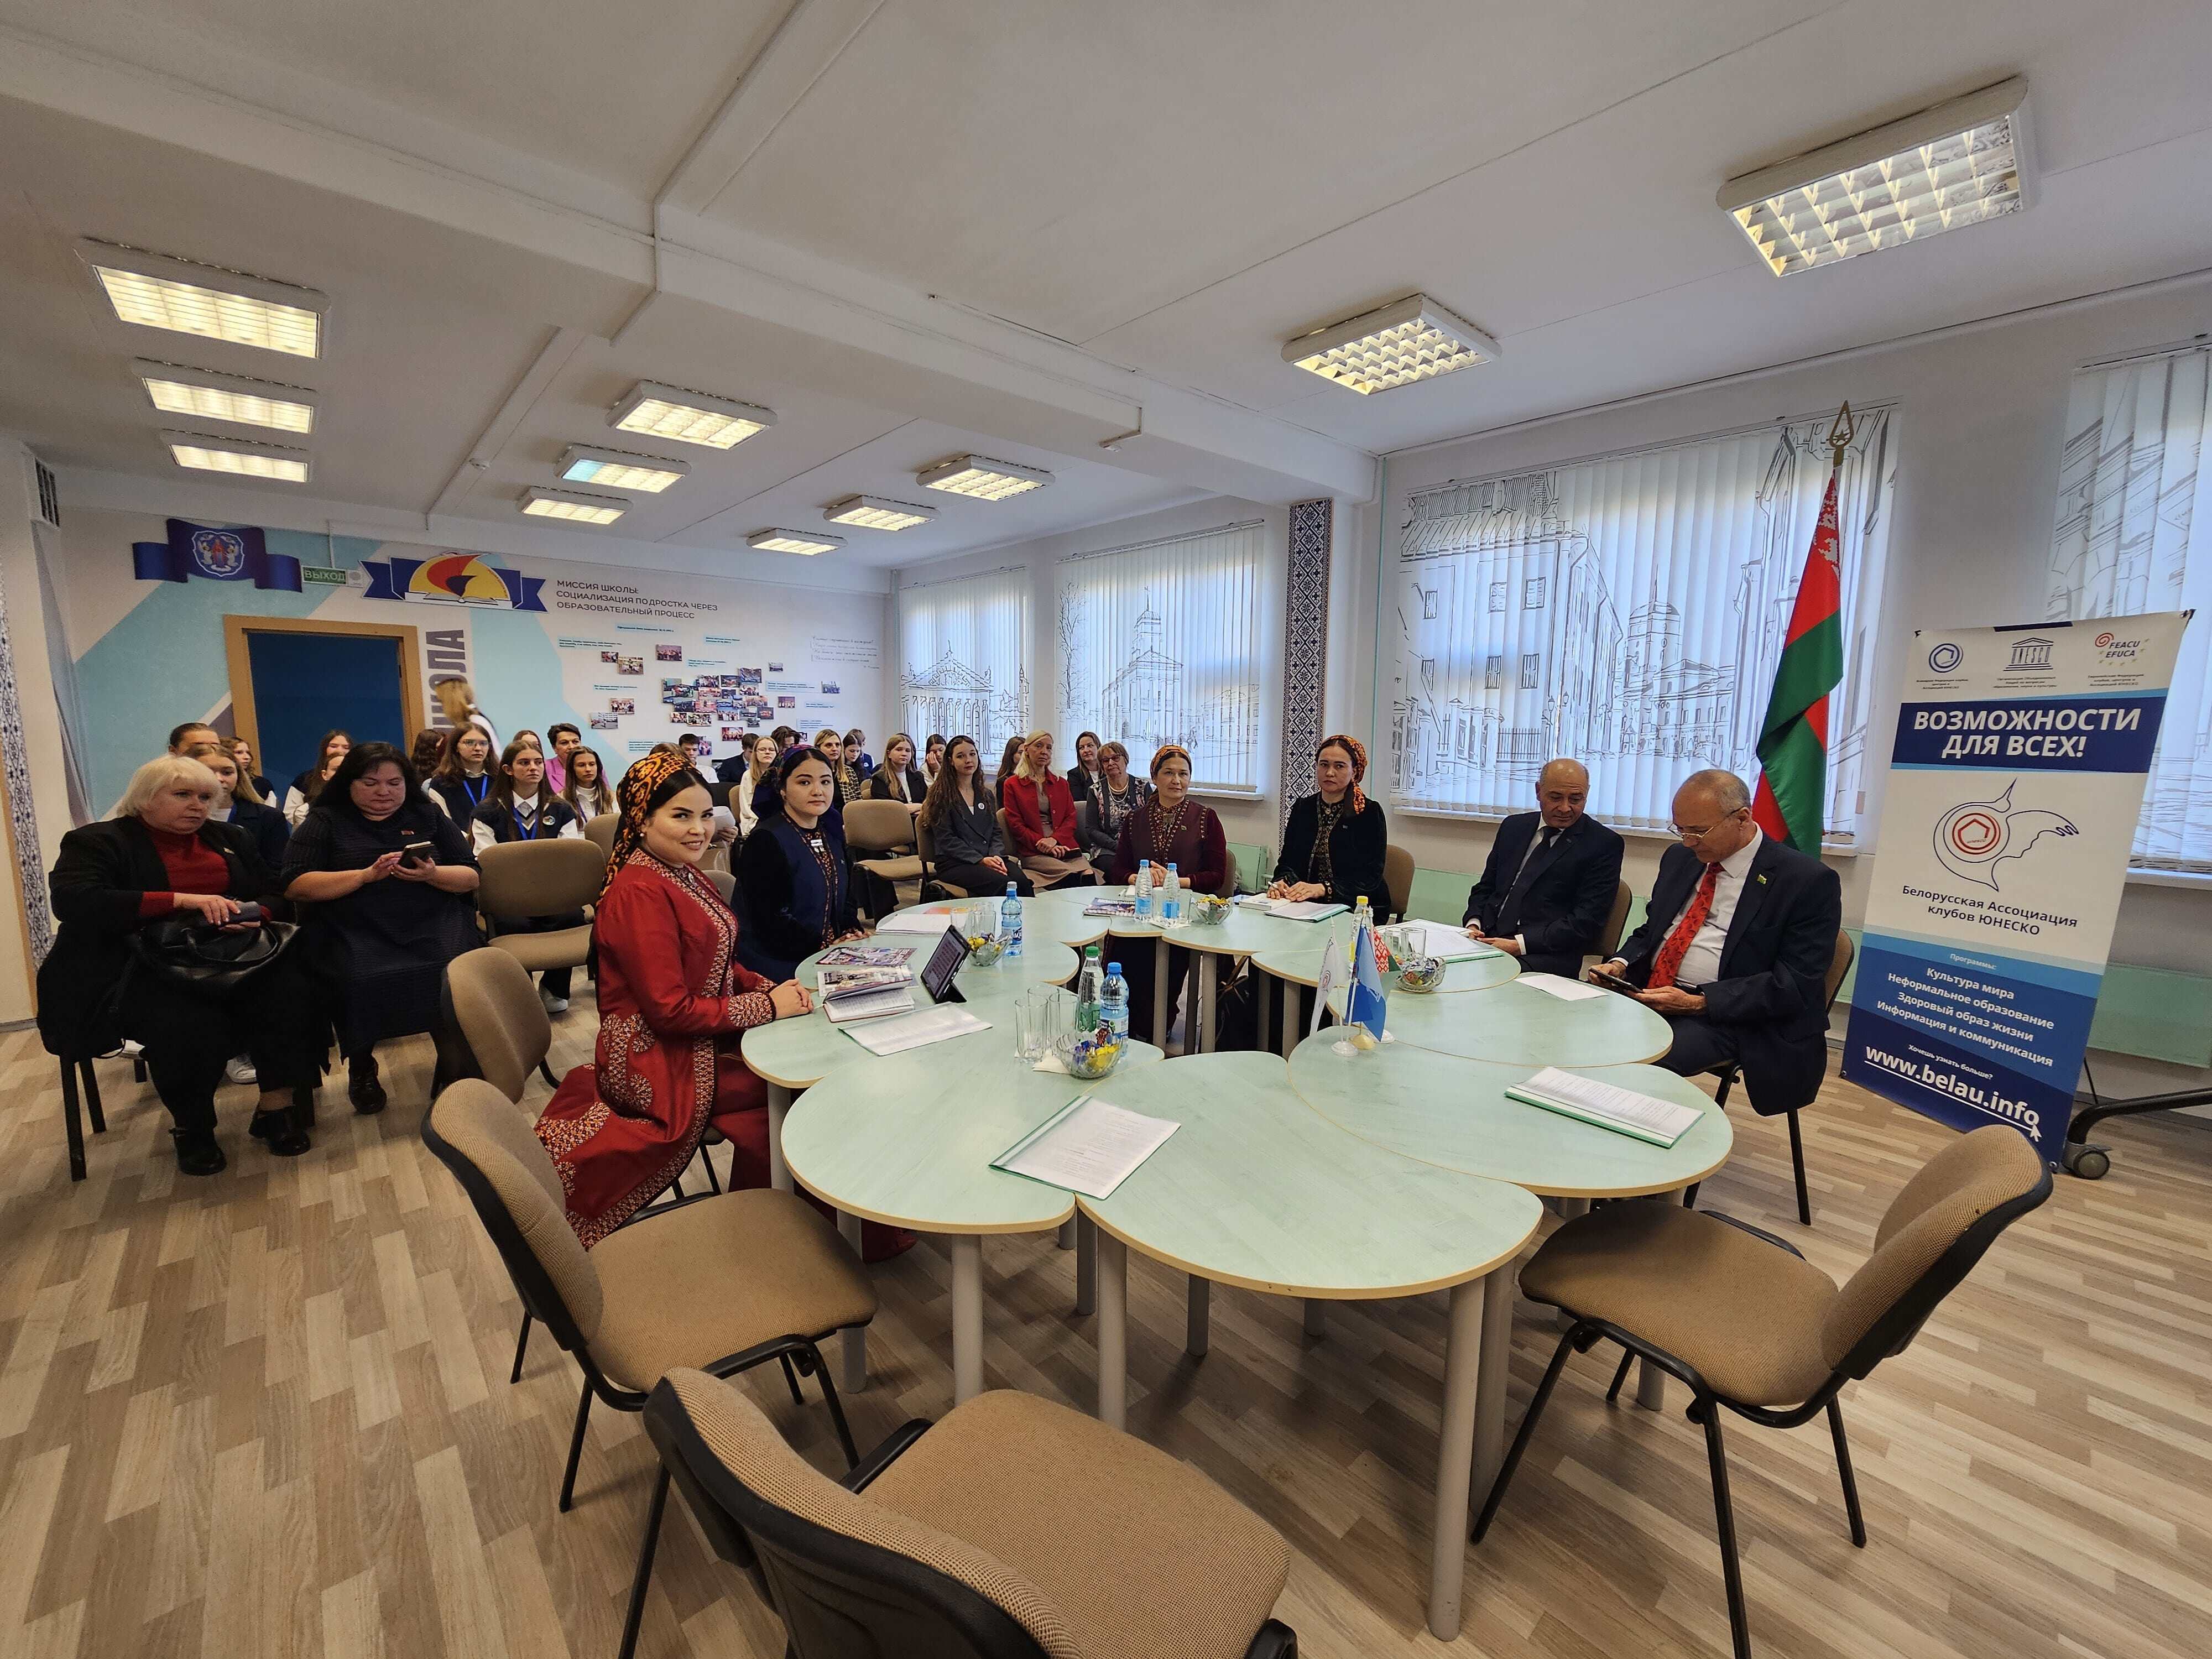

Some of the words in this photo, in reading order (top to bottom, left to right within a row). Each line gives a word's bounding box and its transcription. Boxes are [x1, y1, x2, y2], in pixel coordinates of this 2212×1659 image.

[305, 570, 345, 582] ВЫХОД
[557, 580, 598, 590] МИССИЯ
[556, 591, 633, 603] СОЦИАЛИЗАЦИЯ
[636, 598, 689, 608] ПОДРОСТКА
[557, 602, 652, 616] ОБРАЗОВАТЕЛЬНЫЙ
[655, 610, 695, 619] ПРОЦЕСС
[2109, 640, 2141, 649] FEACU
[1914, 708, 2141, 731] ВОЗМОЖНОСТИ
[1942, 735, 2000, 759] ДЛЯ
[2006, 736, 2086, 757] ВСЕХ!
[1902, 885, 1984, 909] Белорусская
[1987, 901, 2078, 927] Ассоциация
[1928, 905, 1975, 922] клубов
[1979, 914, 2040, 935] ЮНЕСКО
[1927, 968, 1979, 989] Культура
[1982, 984, 2015, 999] мира
[1888, 973, 1971, 1004] Неформальное
[1973, 1000, 2054, 1030] образование
[1897, 992, 1954, 1016] Здоровый
[1955, 1011, 1990, 1025] образ
[1991, 1022, 2034, 1042] жизни
[1877, 1000, 1947, 1031] Информация
[1949, 1025, 1957, 1034] и
[1959, 1029, 2053, 1067] коммуникация
[1908, 1044, 1935, 1059] Хочешь
[1936, 1053, 1959, 1068] узнать
[1960, 1063, 1993, 1080] больше?
[1866, 1046, 2039, 1125] www.belau.info
